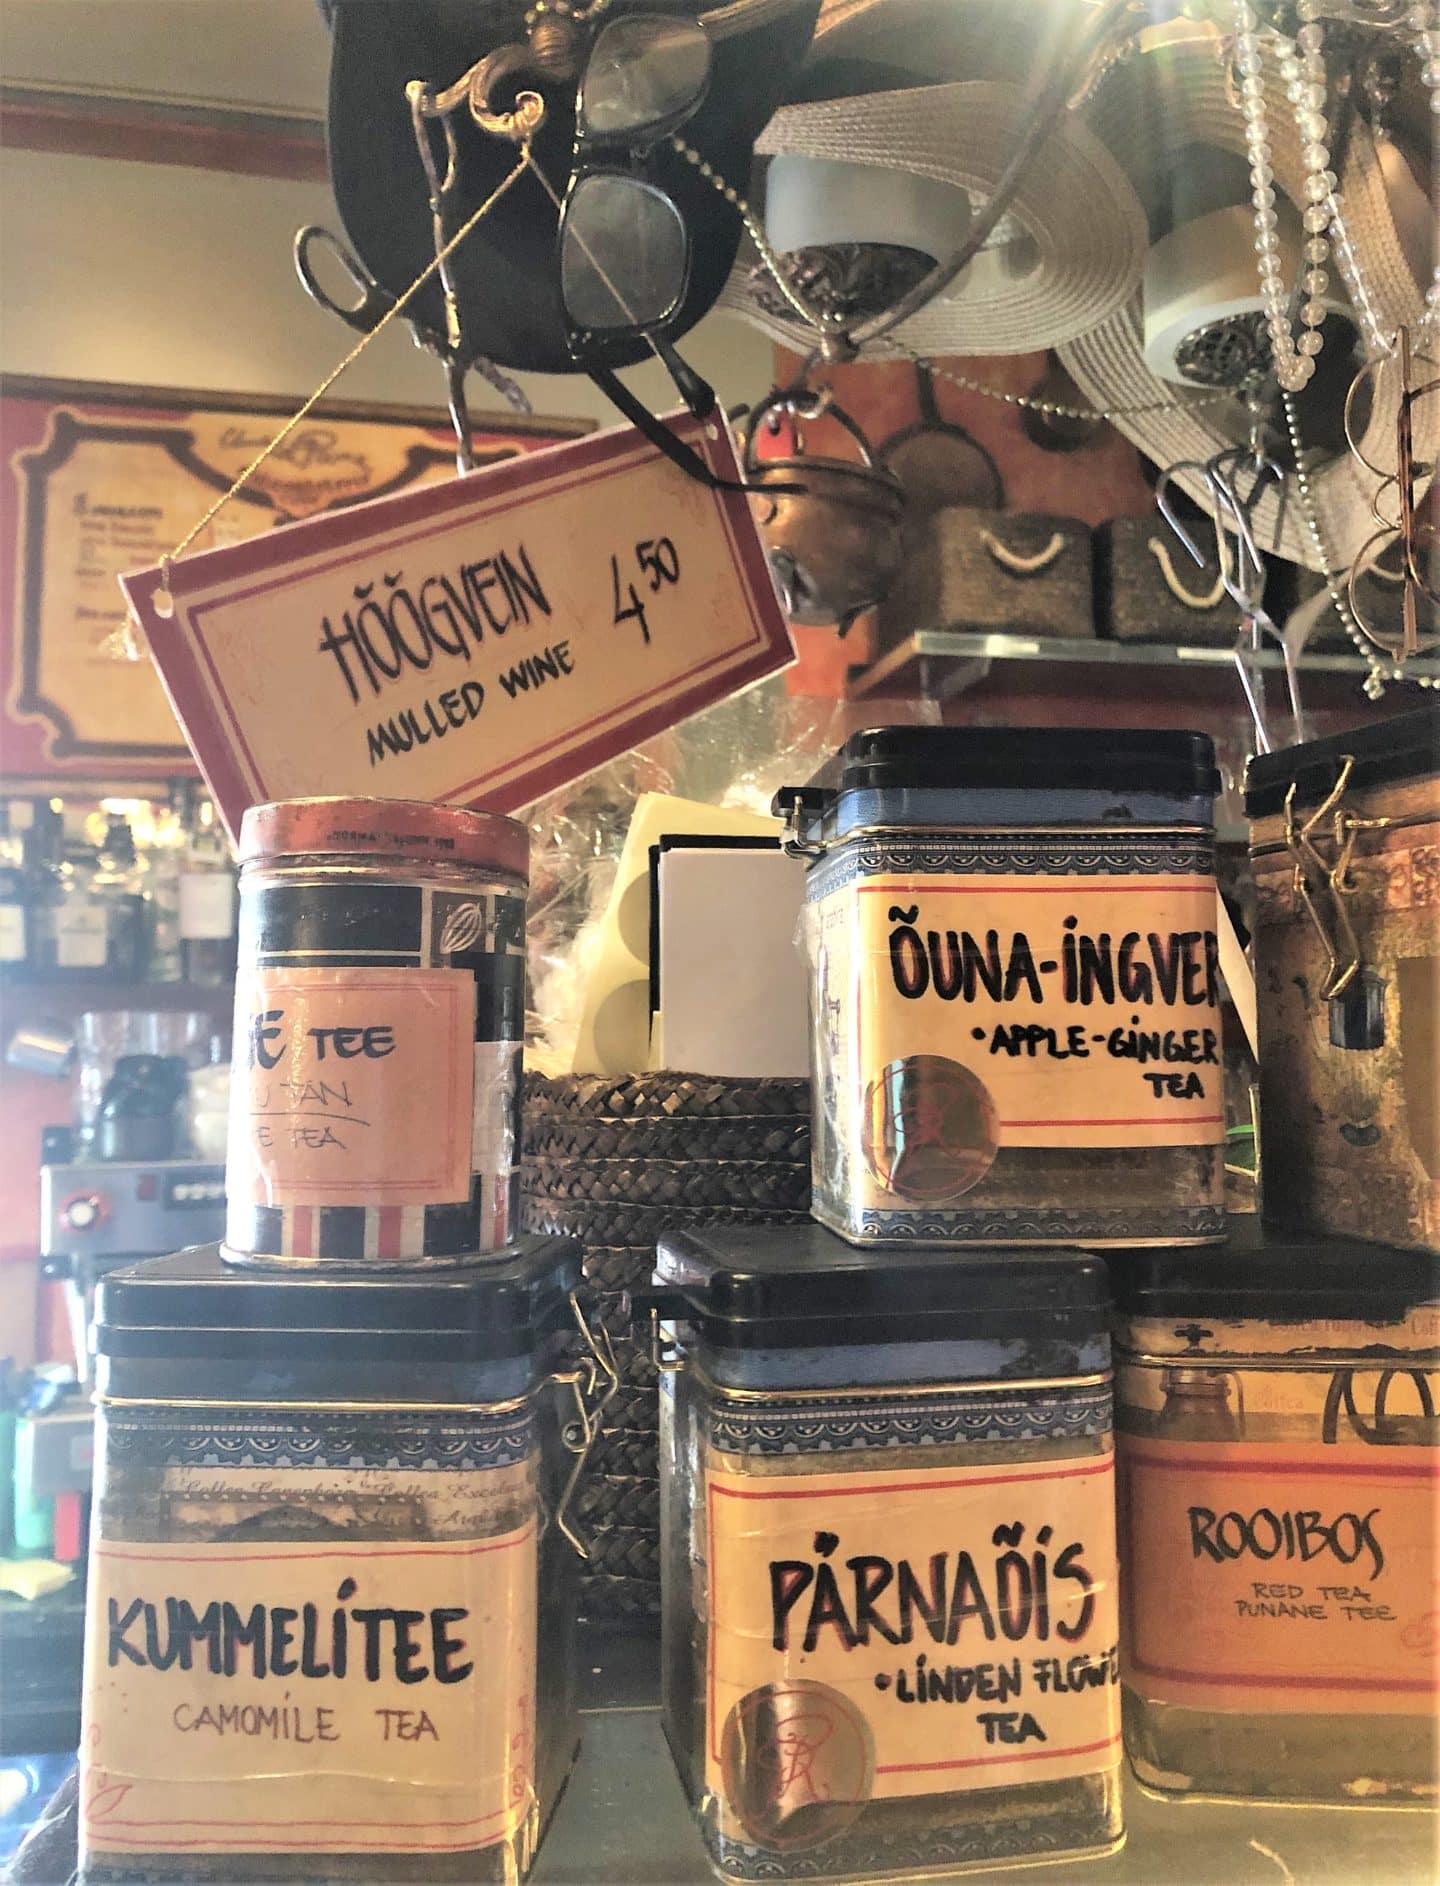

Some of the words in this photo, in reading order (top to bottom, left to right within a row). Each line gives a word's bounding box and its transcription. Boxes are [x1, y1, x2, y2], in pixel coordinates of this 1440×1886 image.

[366, 681, 485, 766] MULLED
[499, 640, 575, 698] WINE
[307, 1025, 397, 1061] TEE
[1143, 1072, 1205, 1099] TEA
[284, 1126, 347, 1150] TEA
[1187, 1506, 1384, 1581] ROOIBOS
[1251, 1582, 1304, 1599] RED
[1316, 1586, 1372, 1603] TEA
[1235, 1599, 1329, 1621] PUNANE
[1339, 1604, 1398, 1621] TEE
[173, 1690, 340, 1743] CAMOMILE
[375, 1709, 440, 1742] TEA
[976, 1712, 1047, 1744] TEA
